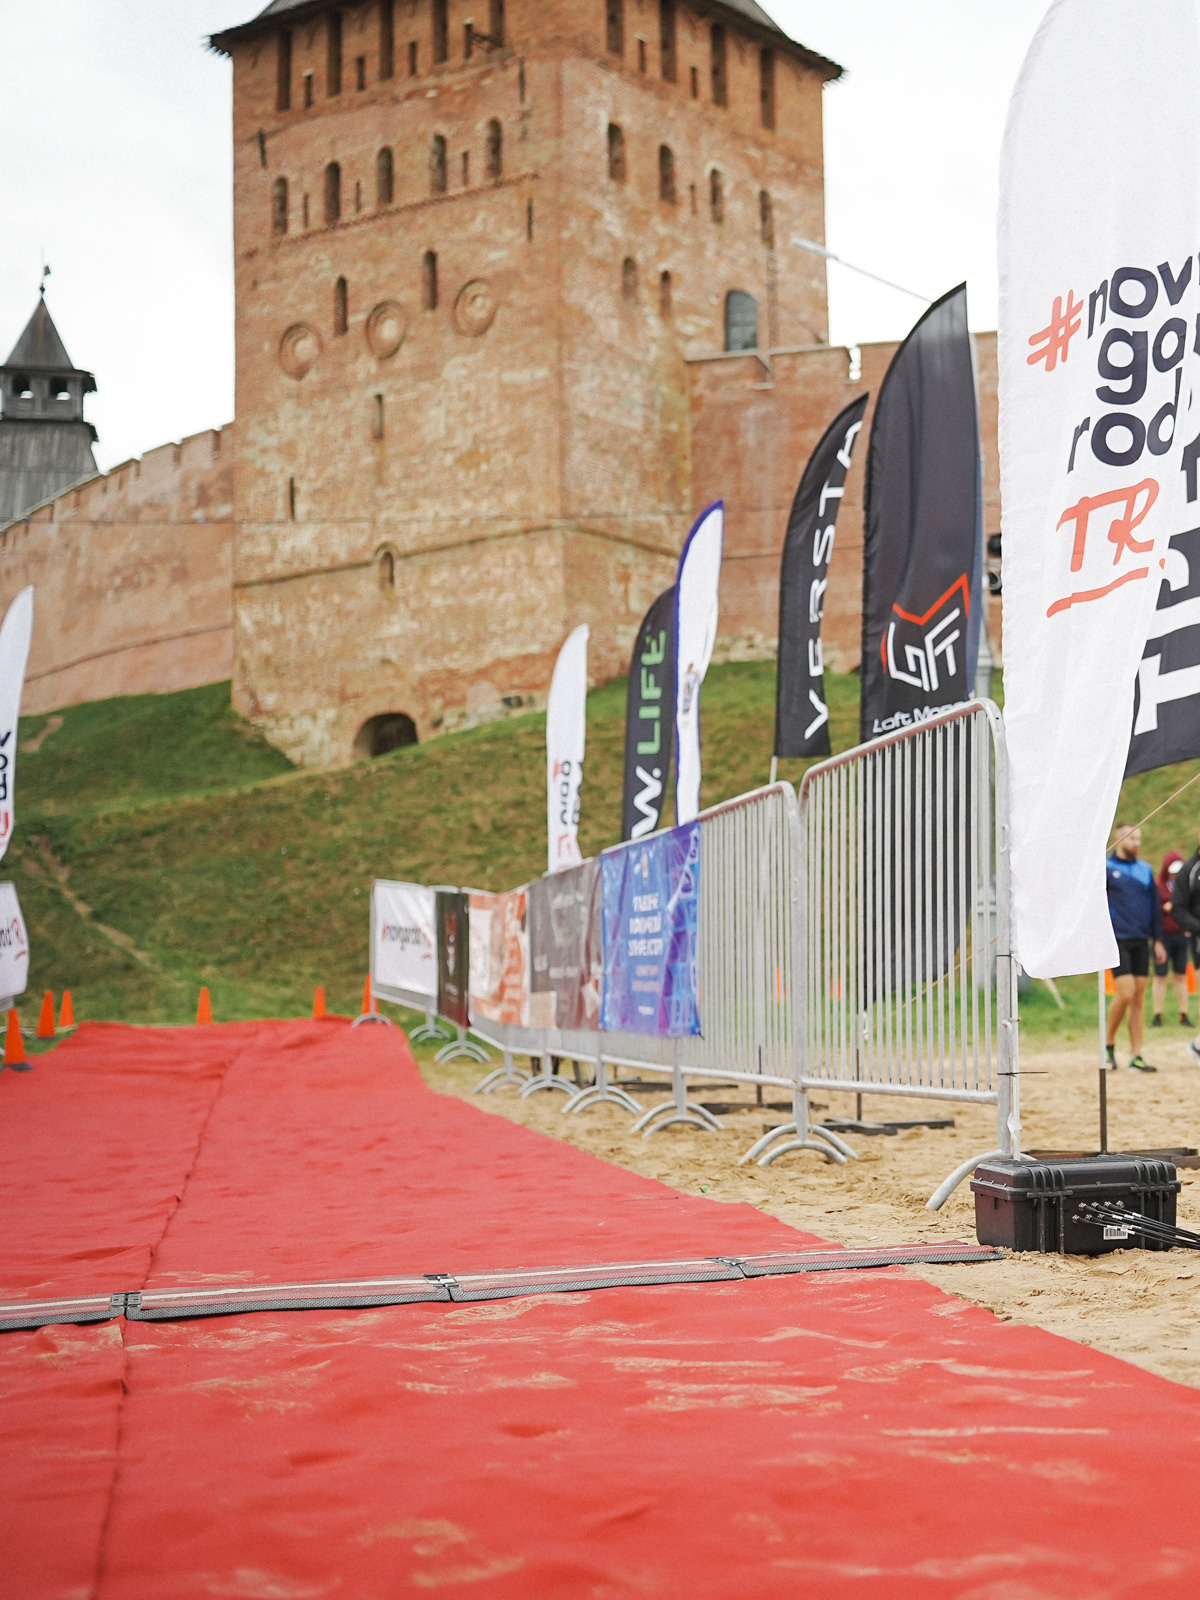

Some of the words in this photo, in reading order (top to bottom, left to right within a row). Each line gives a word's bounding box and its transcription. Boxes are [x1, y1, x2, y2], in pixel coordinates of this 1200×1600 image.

[1026, 256, 1193, 371] #nov
[1067, 367, 1183, 474] rod
[1056, 477, 1165, 572] TR
[873, 708, 913, 734] Loft
